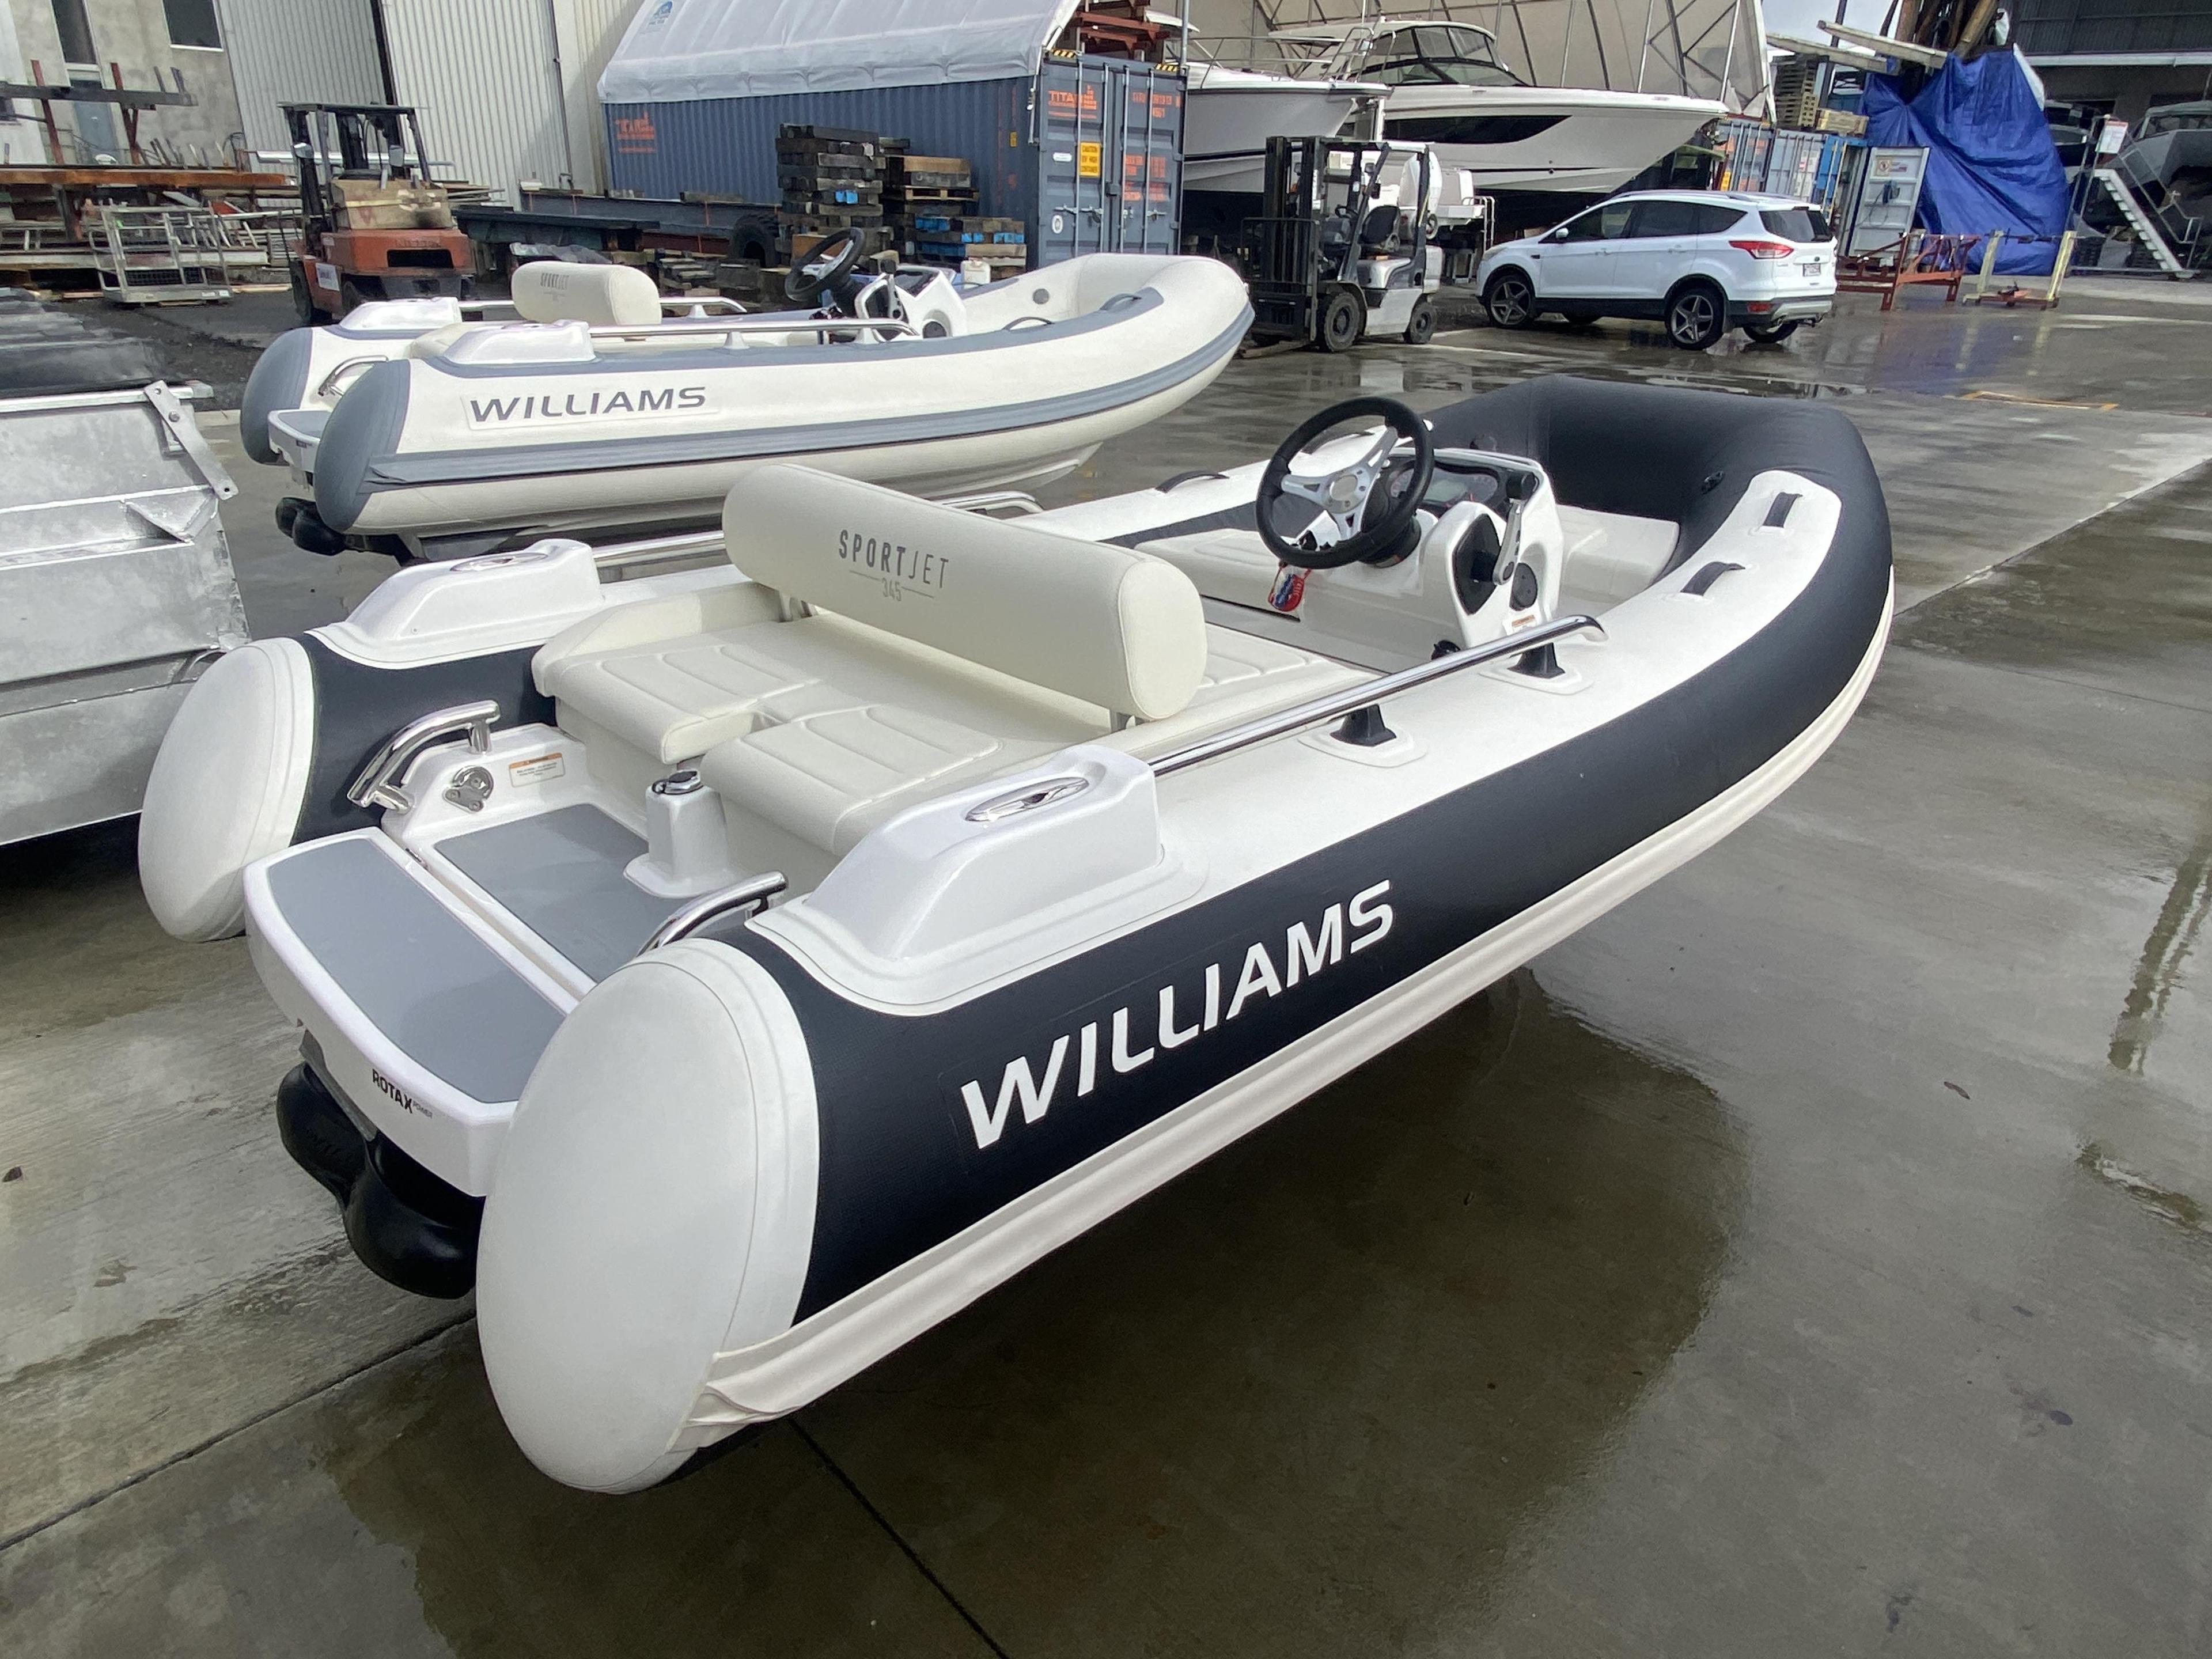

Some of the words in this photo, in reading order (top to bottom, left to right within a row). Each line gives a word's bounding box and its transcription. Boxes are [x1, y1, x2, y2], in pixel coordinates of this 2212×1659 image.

[470, 387, 706, 422] WILLIAMS
[881, 577, 902, 602] 345
[961, 879, 1393, 1150] WILLIAMS
[372, 1069, 412, 1114] ROTAX
